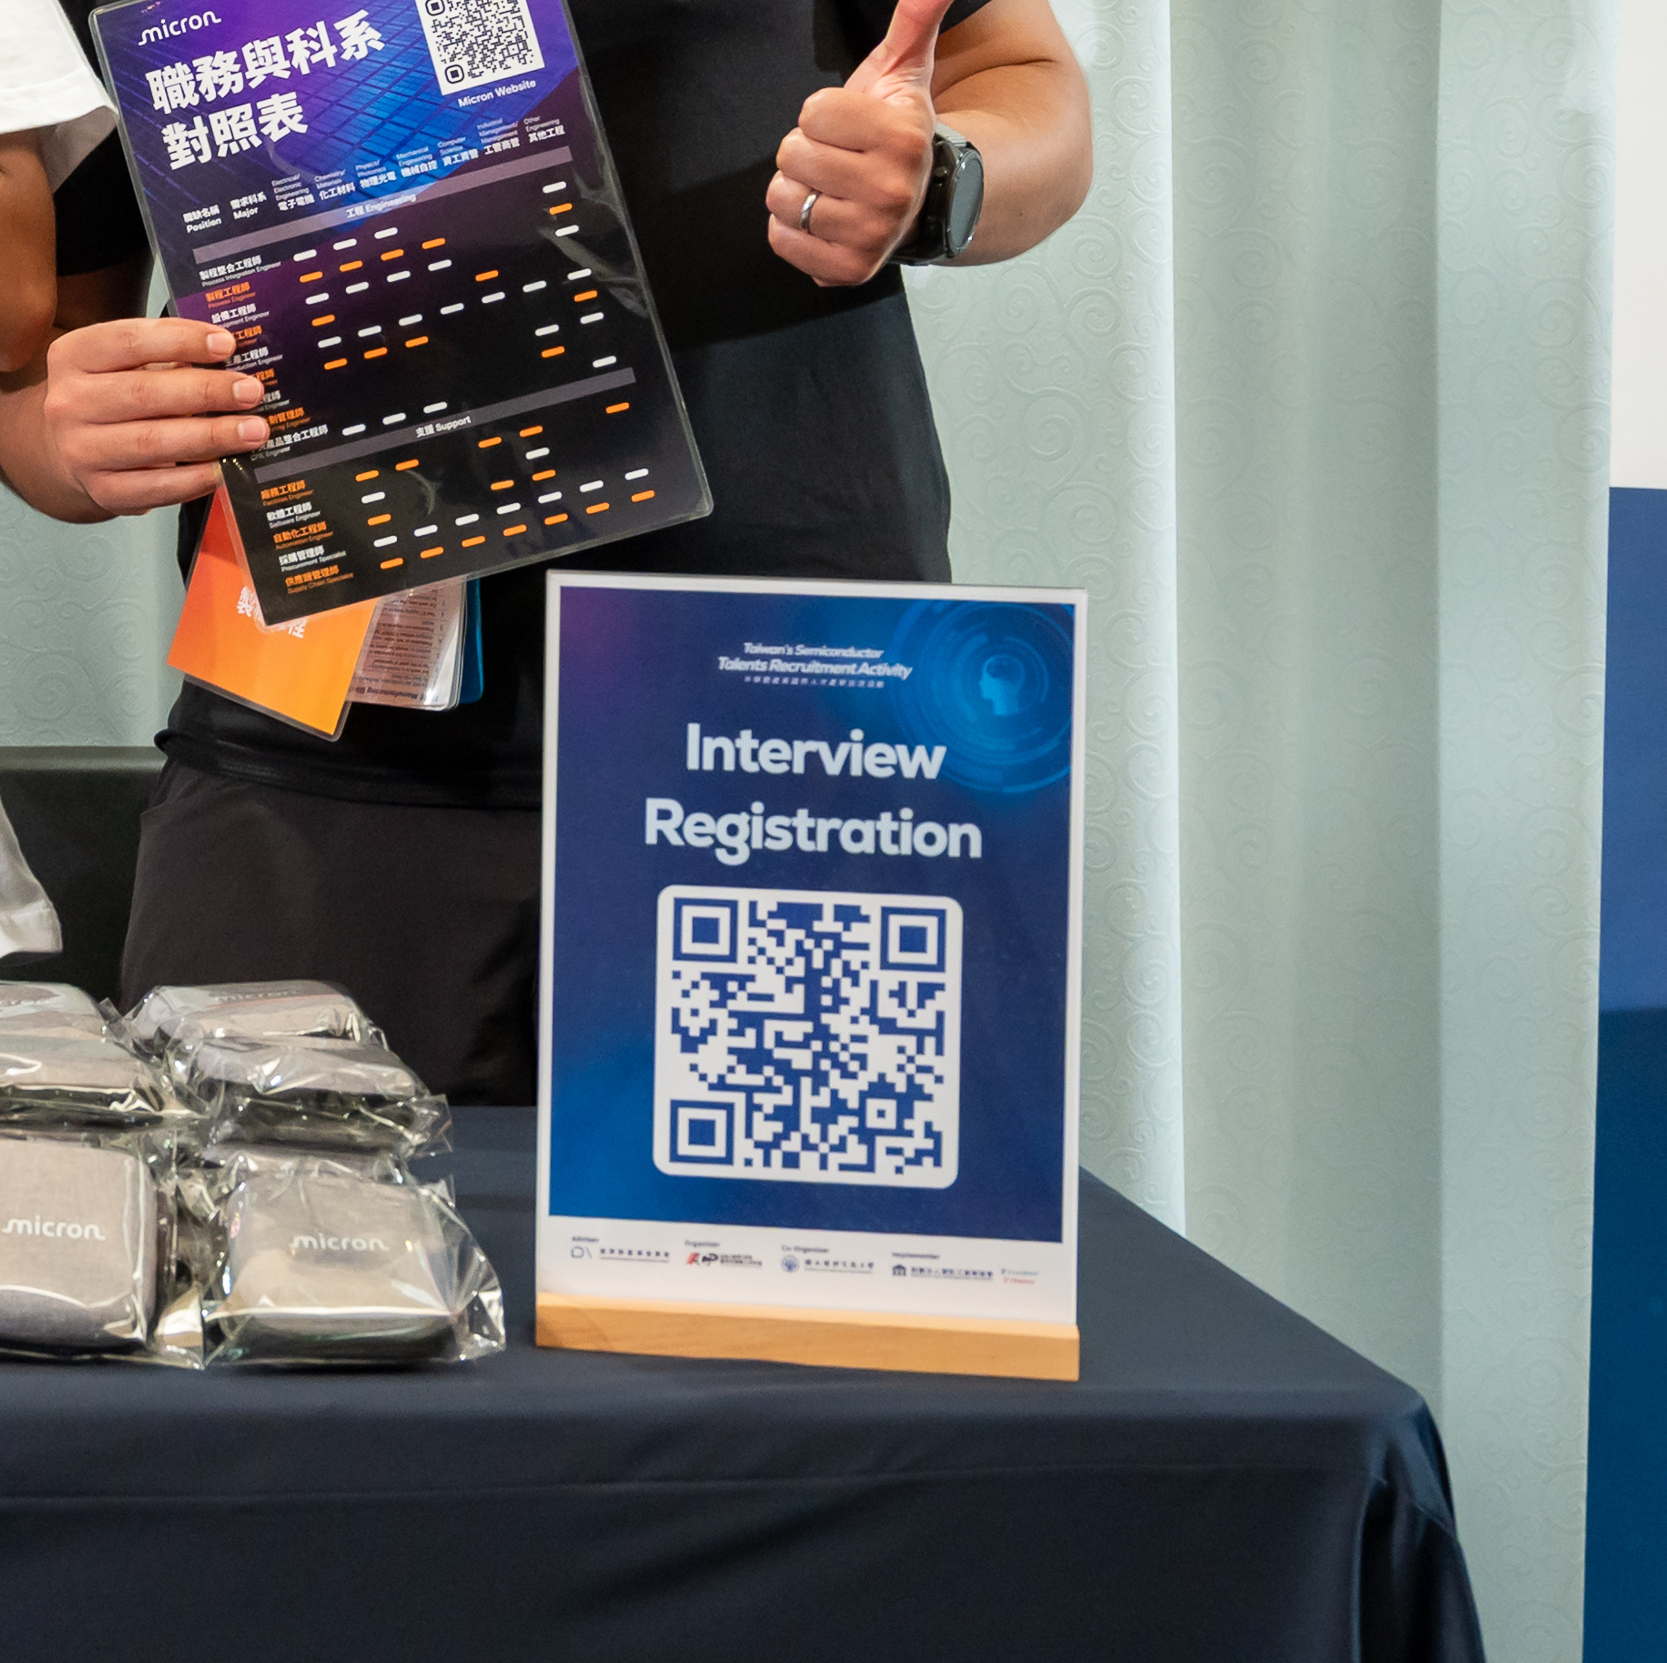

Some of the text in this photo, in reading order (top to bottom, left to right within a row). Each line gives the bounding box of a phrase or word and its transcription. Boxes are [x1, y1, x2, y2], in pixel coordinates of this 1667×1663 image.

[137, 9, 223, 47] micron
[144, 8, 387, 117] 職務與科系
[457, 79, 537, 109] Micron Website
[160, 88, 310, 172] 對照表
[528, 124, 566, 144] 其他工程
[318, 181, 356, 202] 化工材料
[359, 170, 397, 189] 物理光電
[232, 206, 260, 221] Major
[345, 193, 417, 220] 工程 Engineering
[186, 216, 223, 234] Position
[415, 415, 473, 439] 支援 Support
[794, 642, 885, 660] Semiconductor
[717, 656, 768, 674] Talents
[768, 658, 859, 677] Recruitment
[858, 660, 914, 682] Activity
[685, 721, 947, 781] Interview
[644, 796, 983, 867] Registration
[1, 1216, 106, 1242] micron
[289, 1229, 388, 1253] micron
